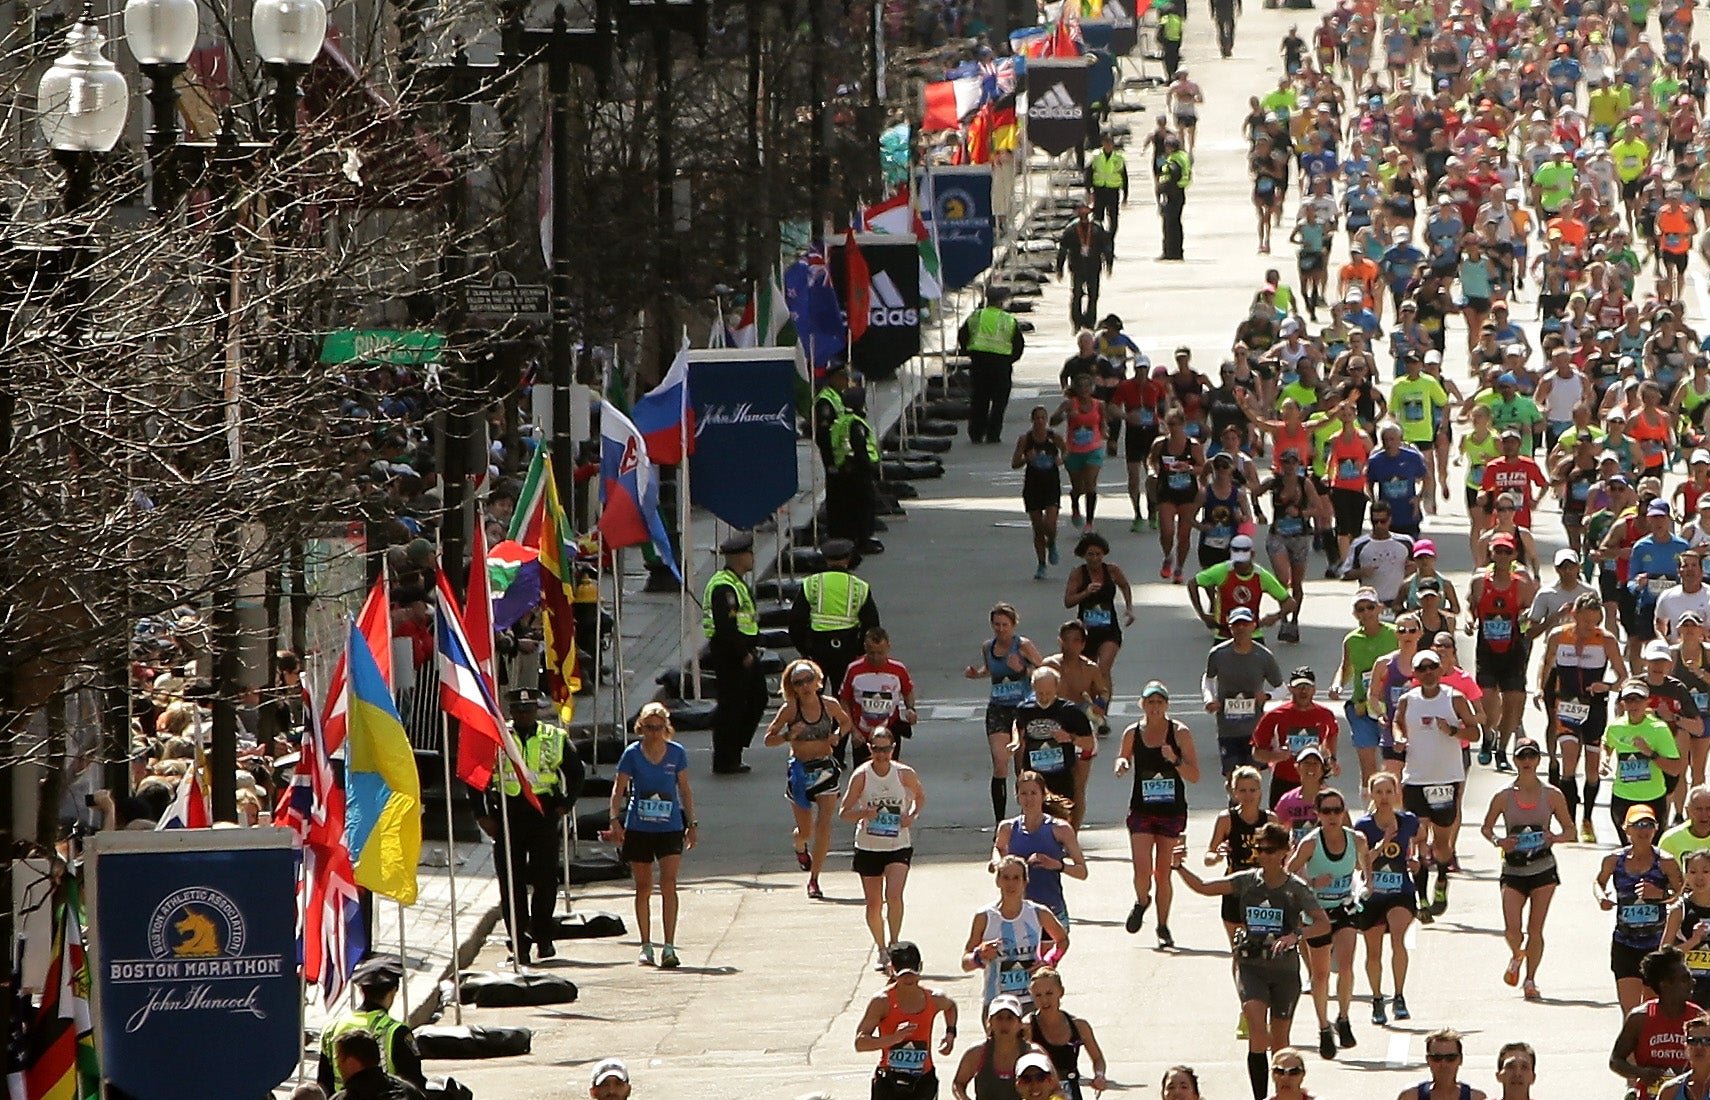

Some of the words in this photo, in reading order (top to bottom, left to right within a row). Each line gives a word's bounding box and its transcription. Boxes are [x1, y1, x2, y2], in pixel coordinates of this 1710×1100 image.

[1029, 106, 1082, 120] adidas
[728, 402, 792, 431] Hancock
[1143, 780, 1175, 791] 19578
[1247, 908, 1284, 920] 19098
[1624, 905, 1659, 917] 21424
[110, 962, 178, 980] BOSTON
[184, 958, 280, 977] MARATHON
[1000, 971, 1030, 984] 2161
[125, 986, 183, 1034] John
[180, 983, 268, 1020] Hancock
